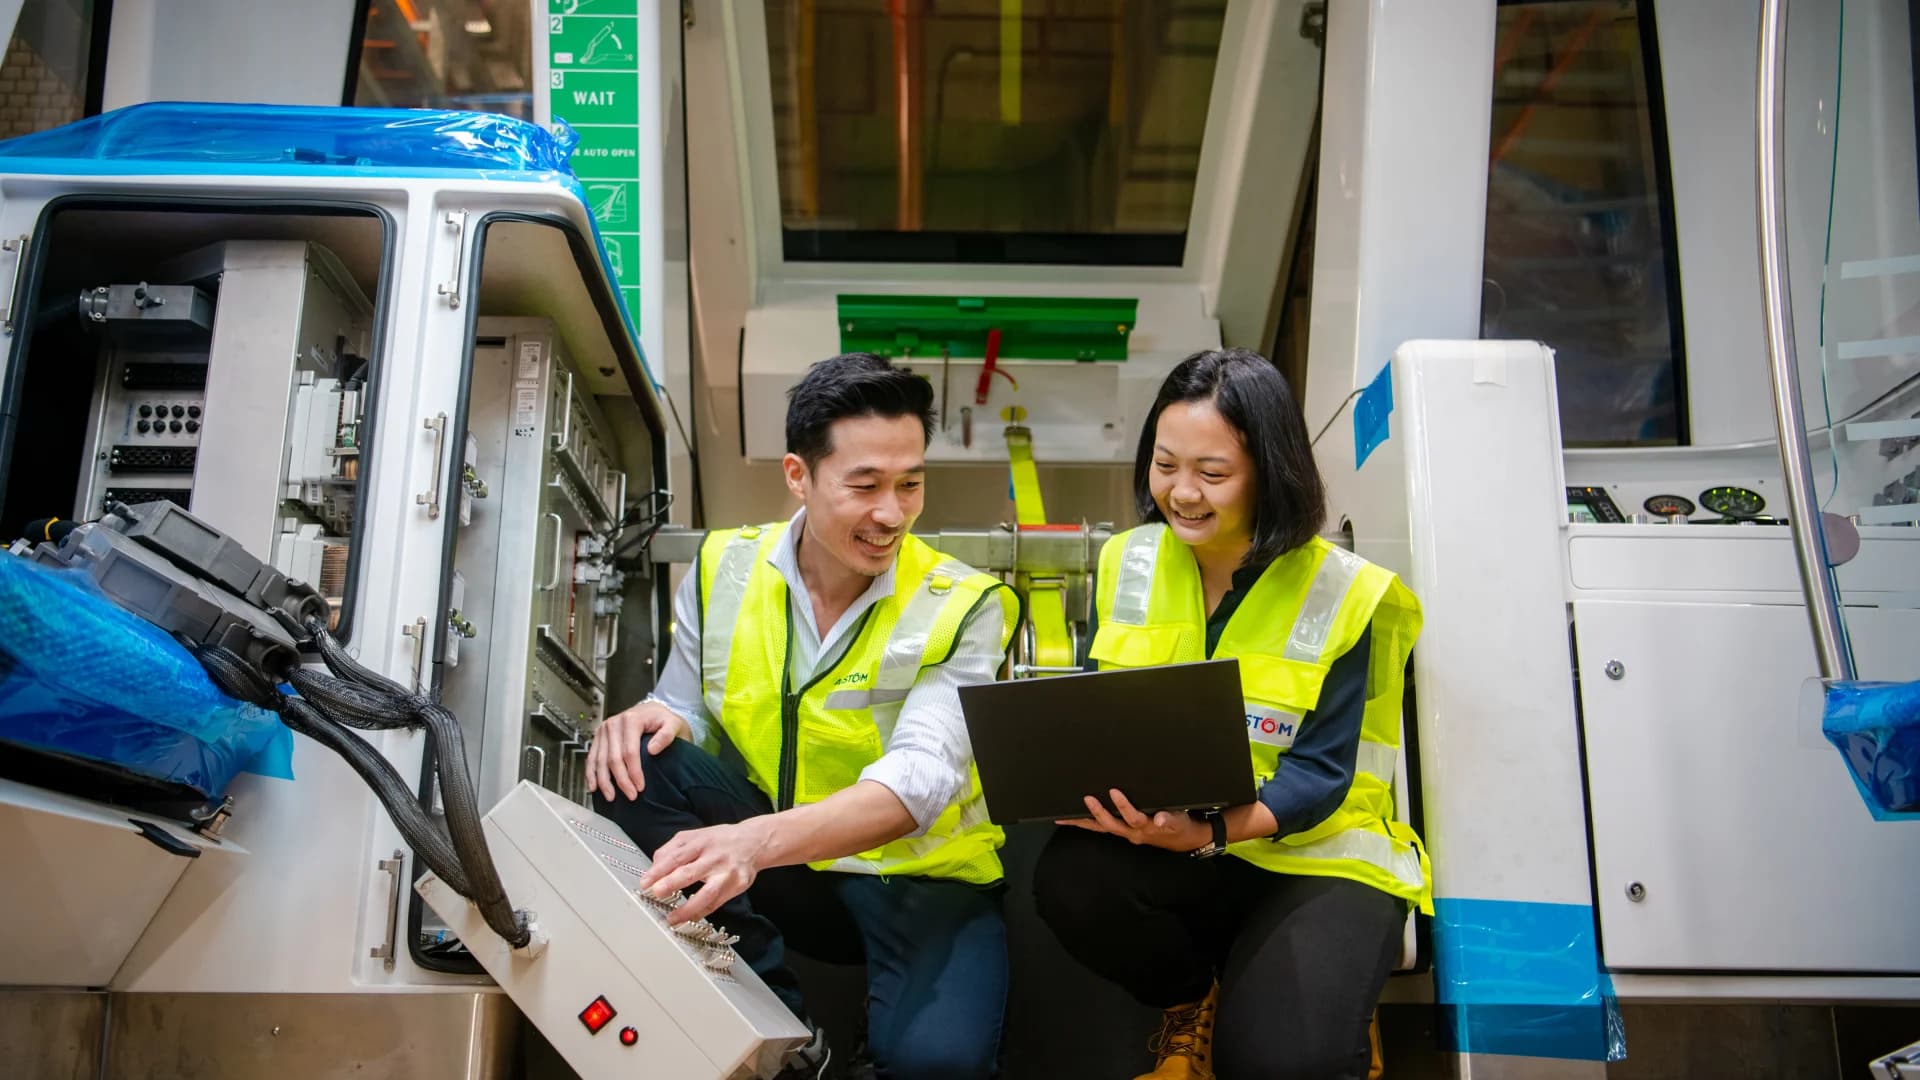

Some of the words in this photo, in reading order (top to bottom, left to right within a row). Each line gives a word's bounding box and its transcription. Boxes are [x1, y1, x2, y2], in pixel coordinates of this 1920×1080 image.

[551, 16, 561, 32] 2
[552, 71, 562, 87] 3
[573, 90, 616, 106] WAIT
[583, 148, 609, 157] AUTO
[611, 148, 636, 157] OPEN
[1244, 714, 1293, 737] STOM
